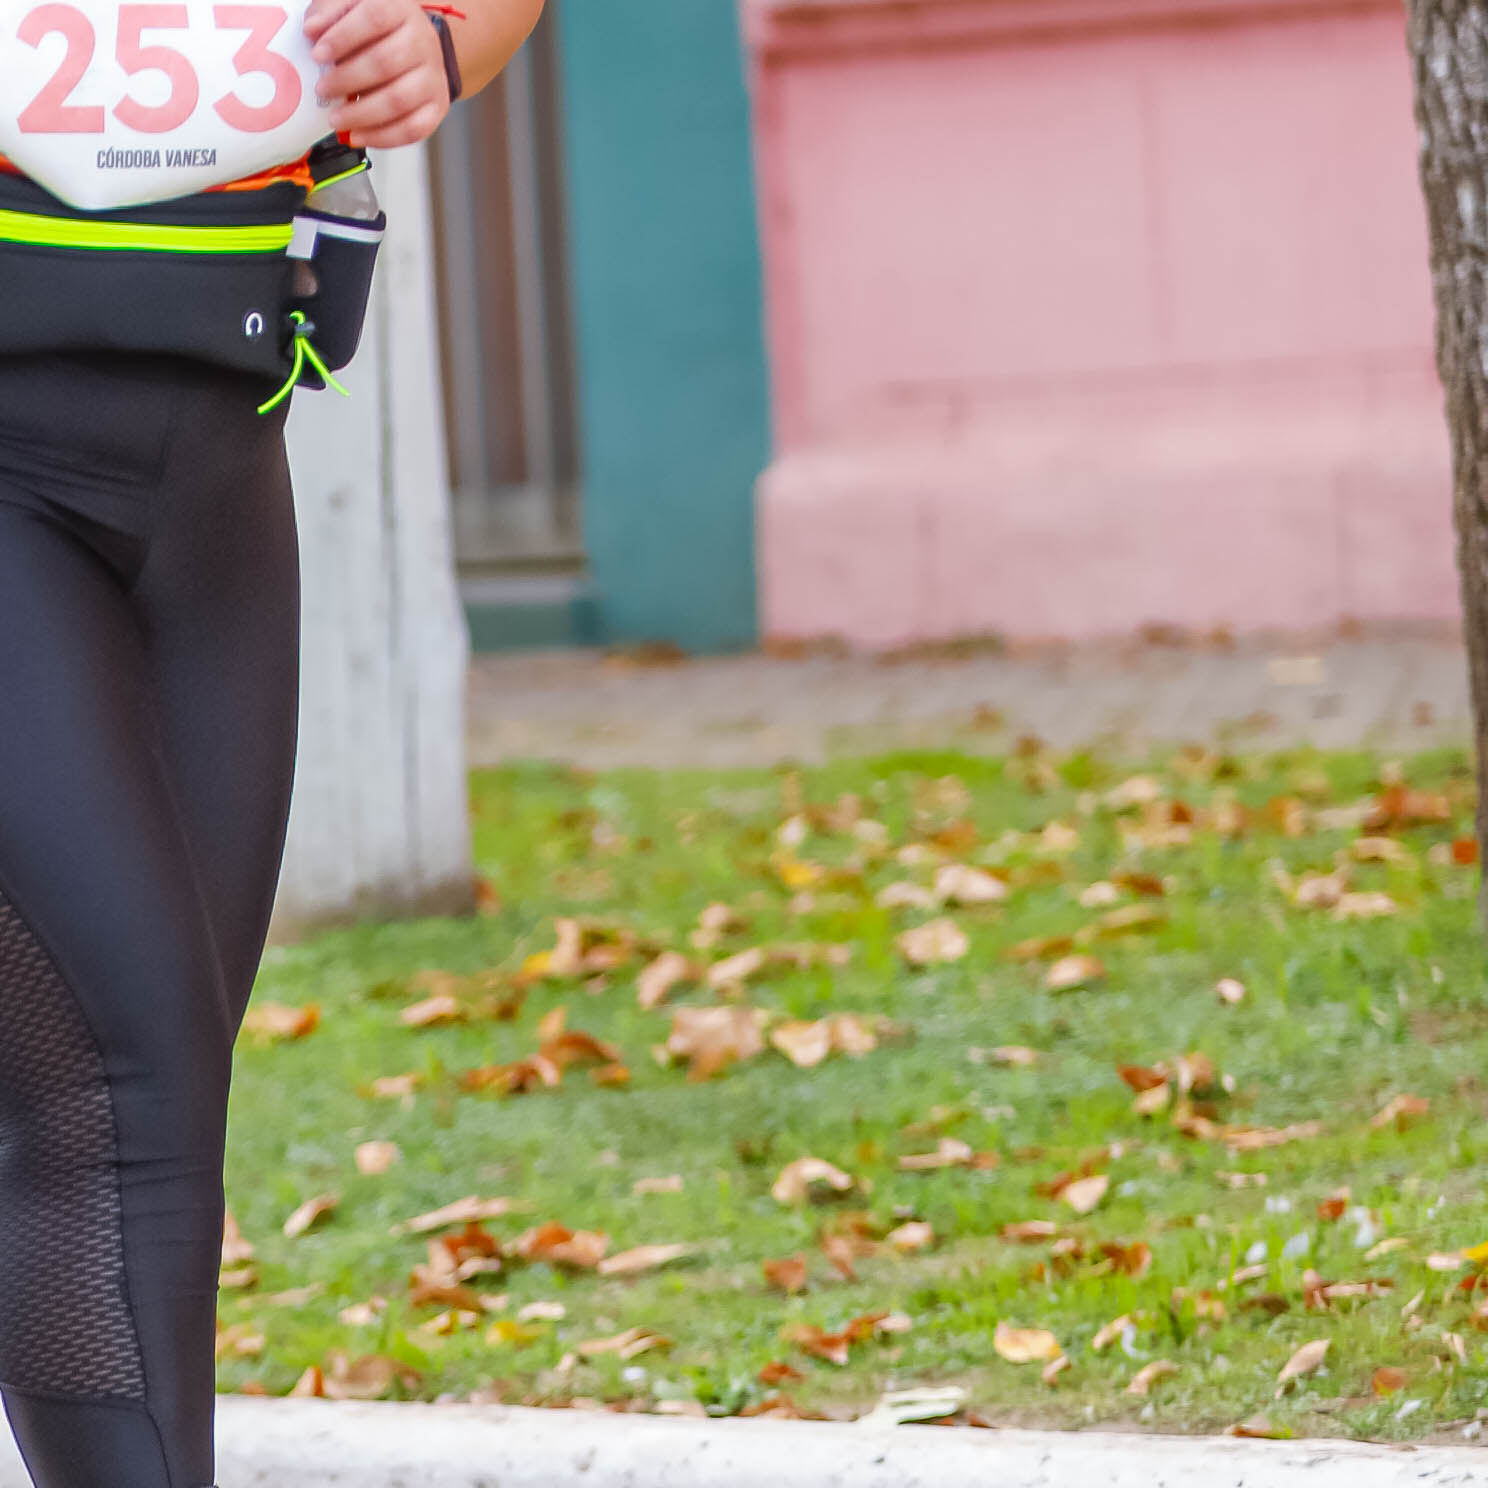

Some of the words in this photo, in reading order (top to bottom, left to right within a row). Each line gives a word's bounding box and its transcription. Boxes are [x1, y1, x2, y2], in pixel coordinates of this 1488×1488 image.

[15, 2, 303, 134] 253
[96, 146, 161, 169] CÓRDOBA
[164, 148, 217, 168] VANESA
